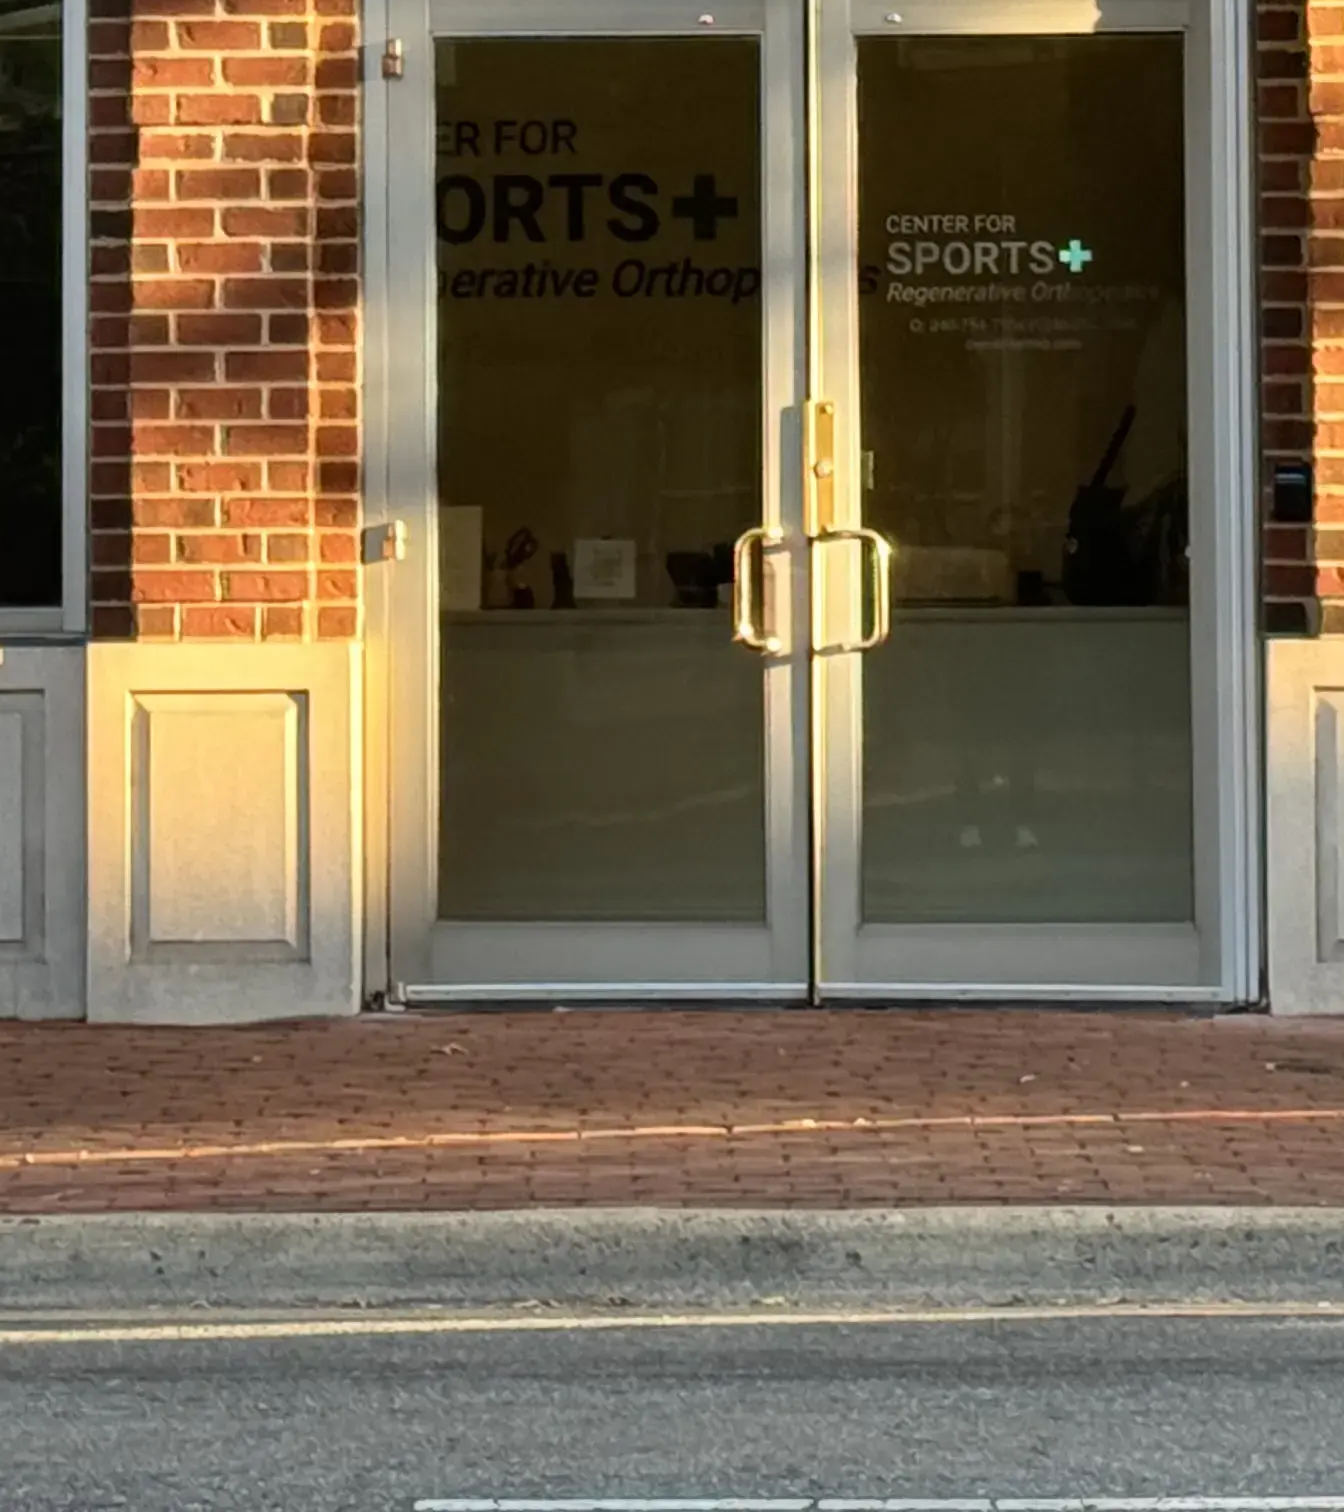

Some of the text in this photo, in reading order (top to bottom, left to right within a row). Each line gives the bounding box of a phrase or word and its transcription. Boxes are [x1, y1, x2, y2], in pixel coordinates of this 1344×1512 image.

[494, 119, 578, 156] FOR
[885, 214, 1017, 234] CENTER FOR
[885, 282, 1027, 307] Regenerative
